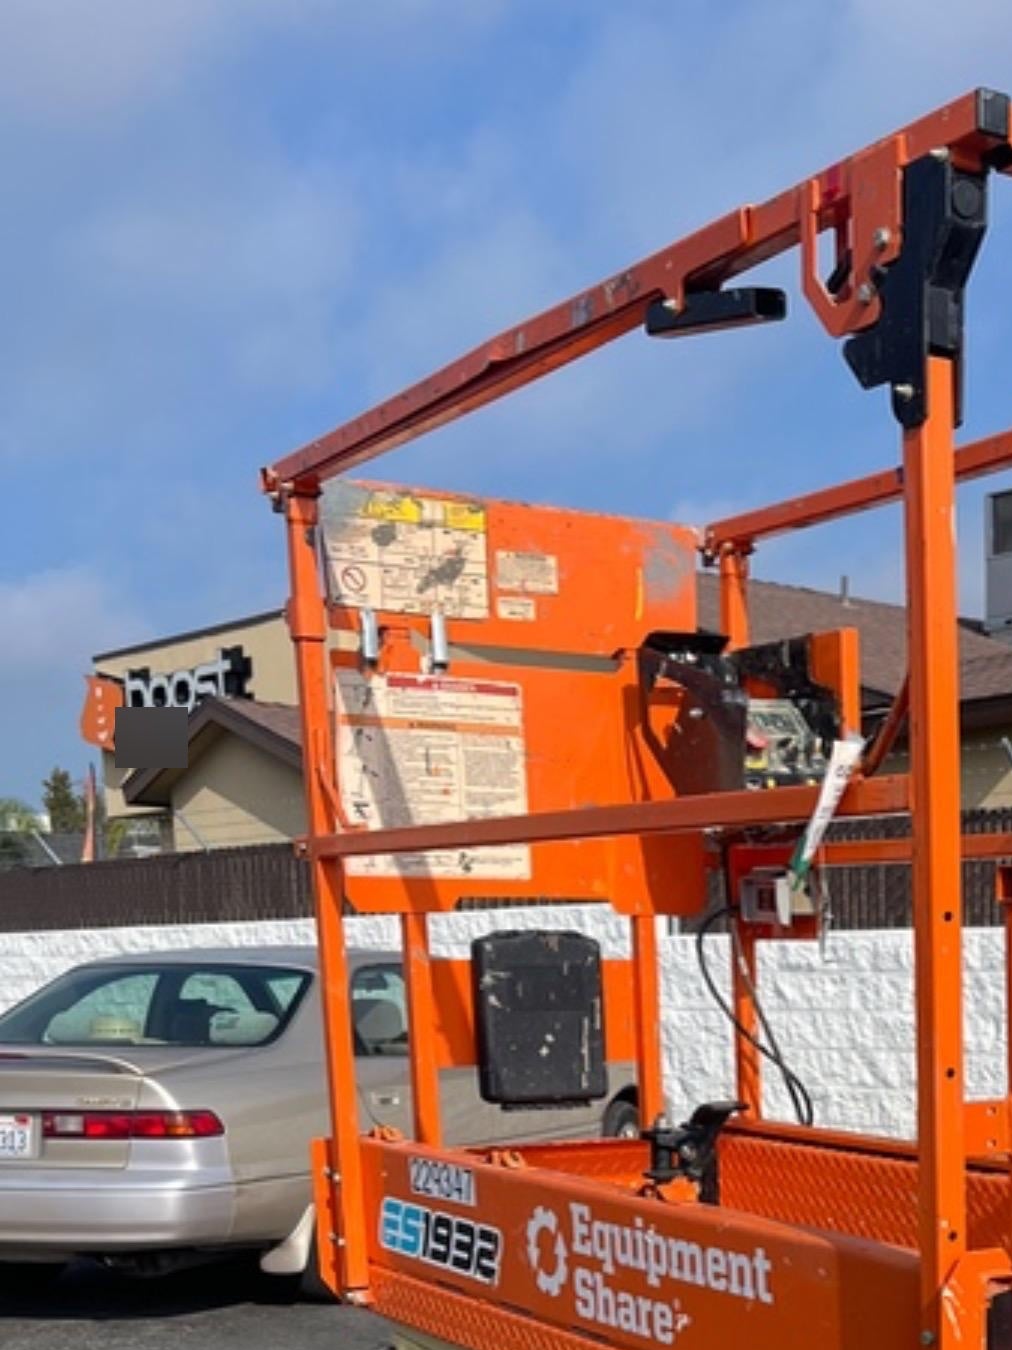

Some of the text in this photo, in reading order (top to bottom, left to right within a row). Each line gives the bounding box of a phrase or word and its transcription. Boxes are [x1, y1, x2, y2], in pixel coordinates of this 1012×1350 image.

[380, 1197, 503, 1284] ES1932
[569, 1202, 775, 1304] Equipment
[573, 1267, 675, 1345] Share
